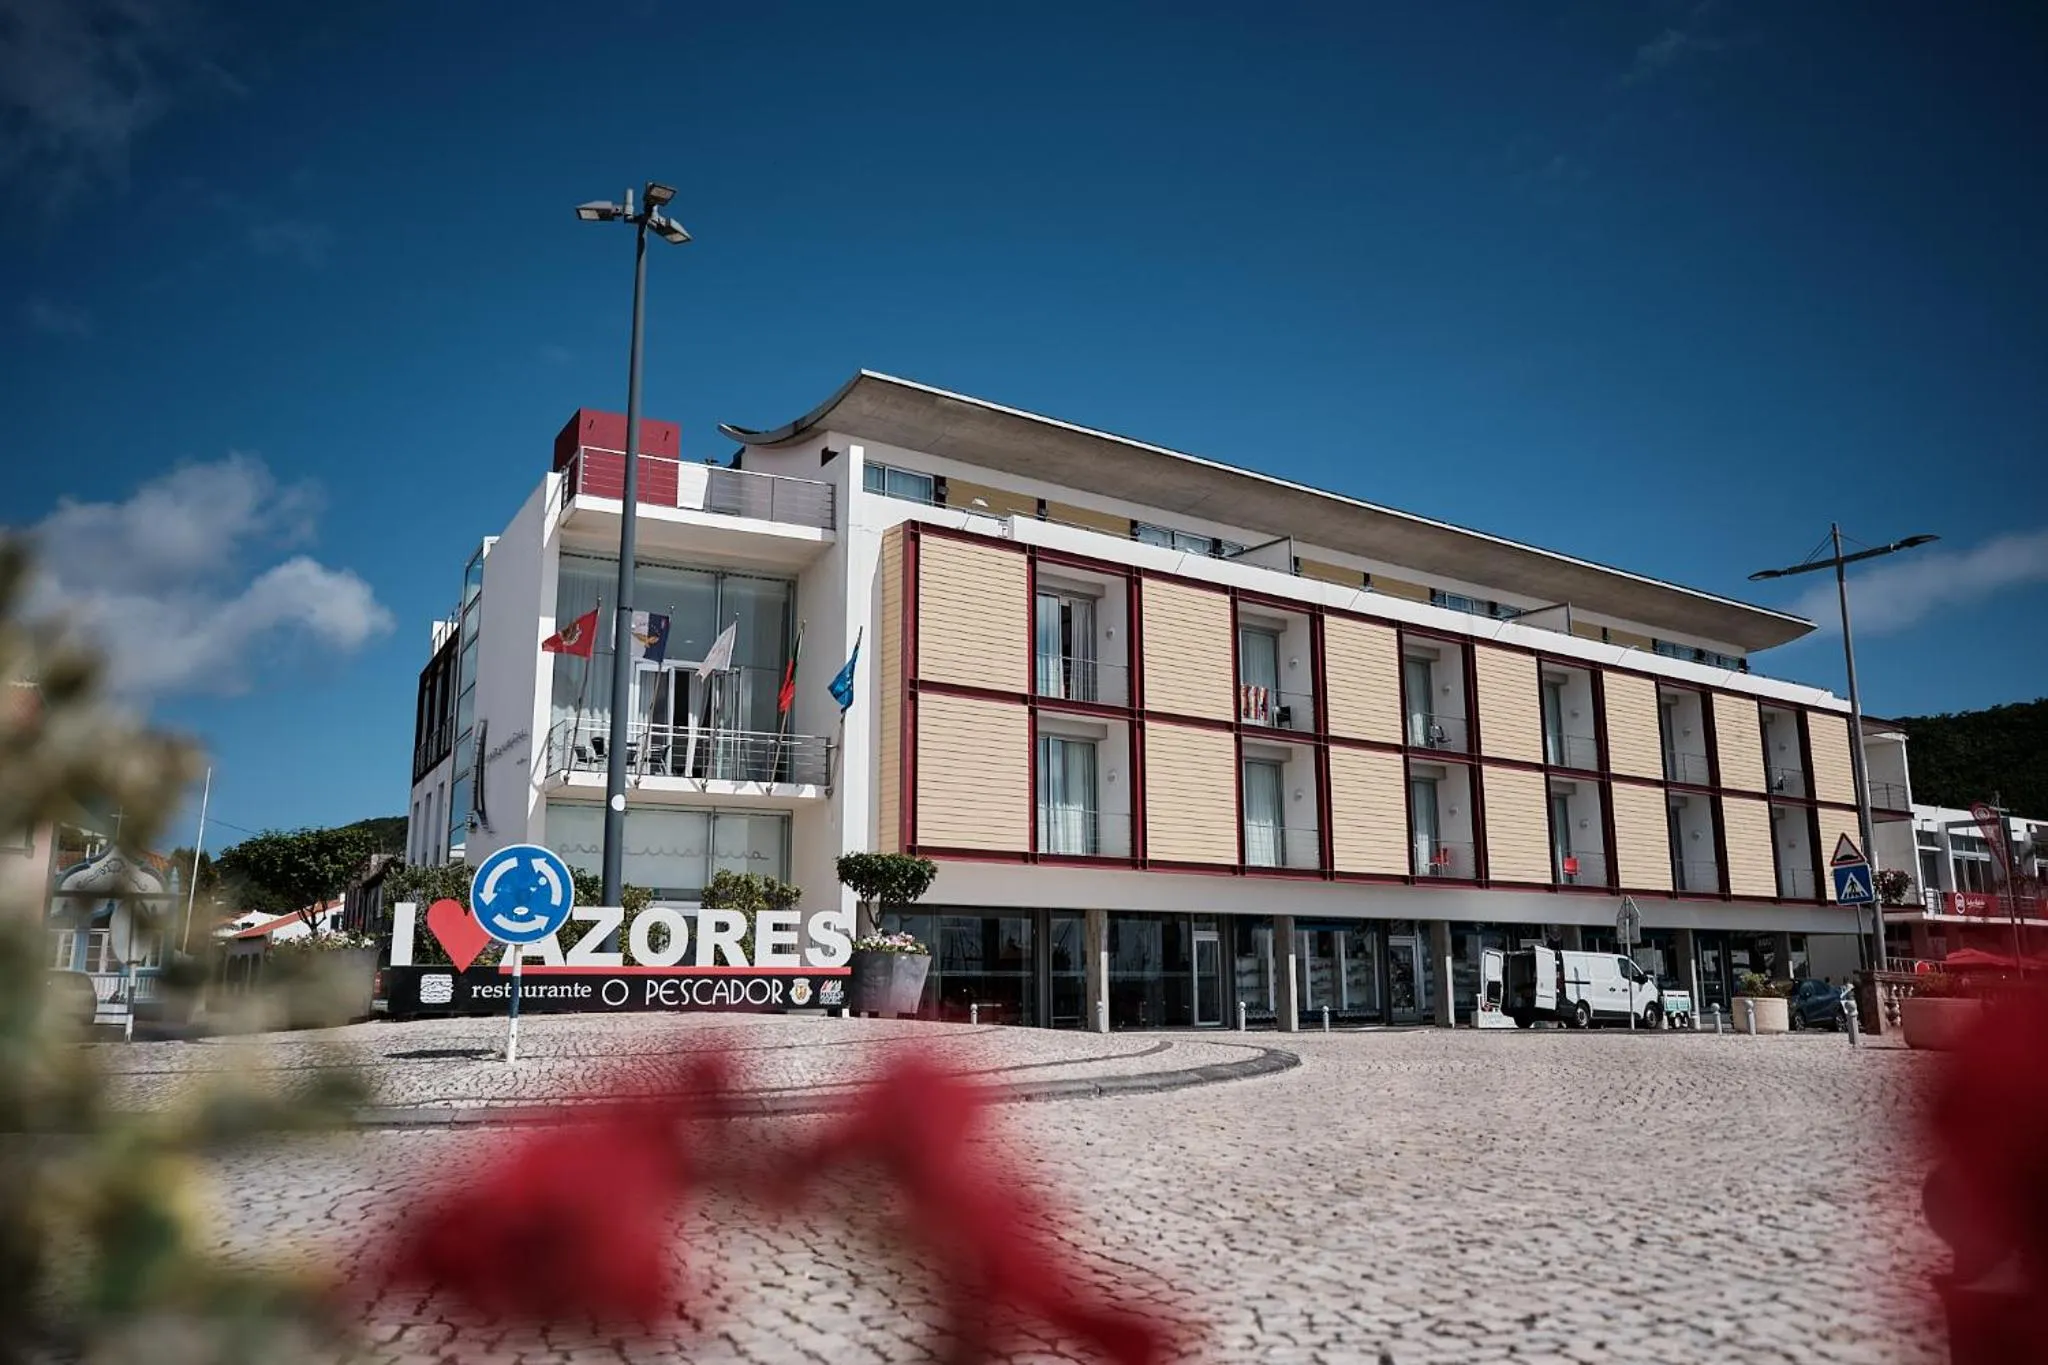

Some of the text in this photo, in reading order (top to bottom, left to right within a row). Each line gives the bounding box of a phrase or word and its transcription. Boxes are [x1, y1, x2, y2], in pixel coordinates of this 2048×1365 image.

[390, 902, 416, 967] I
[601, 979, 629, 1006] O
[645, 978, 783, 1006] PESCADOR
